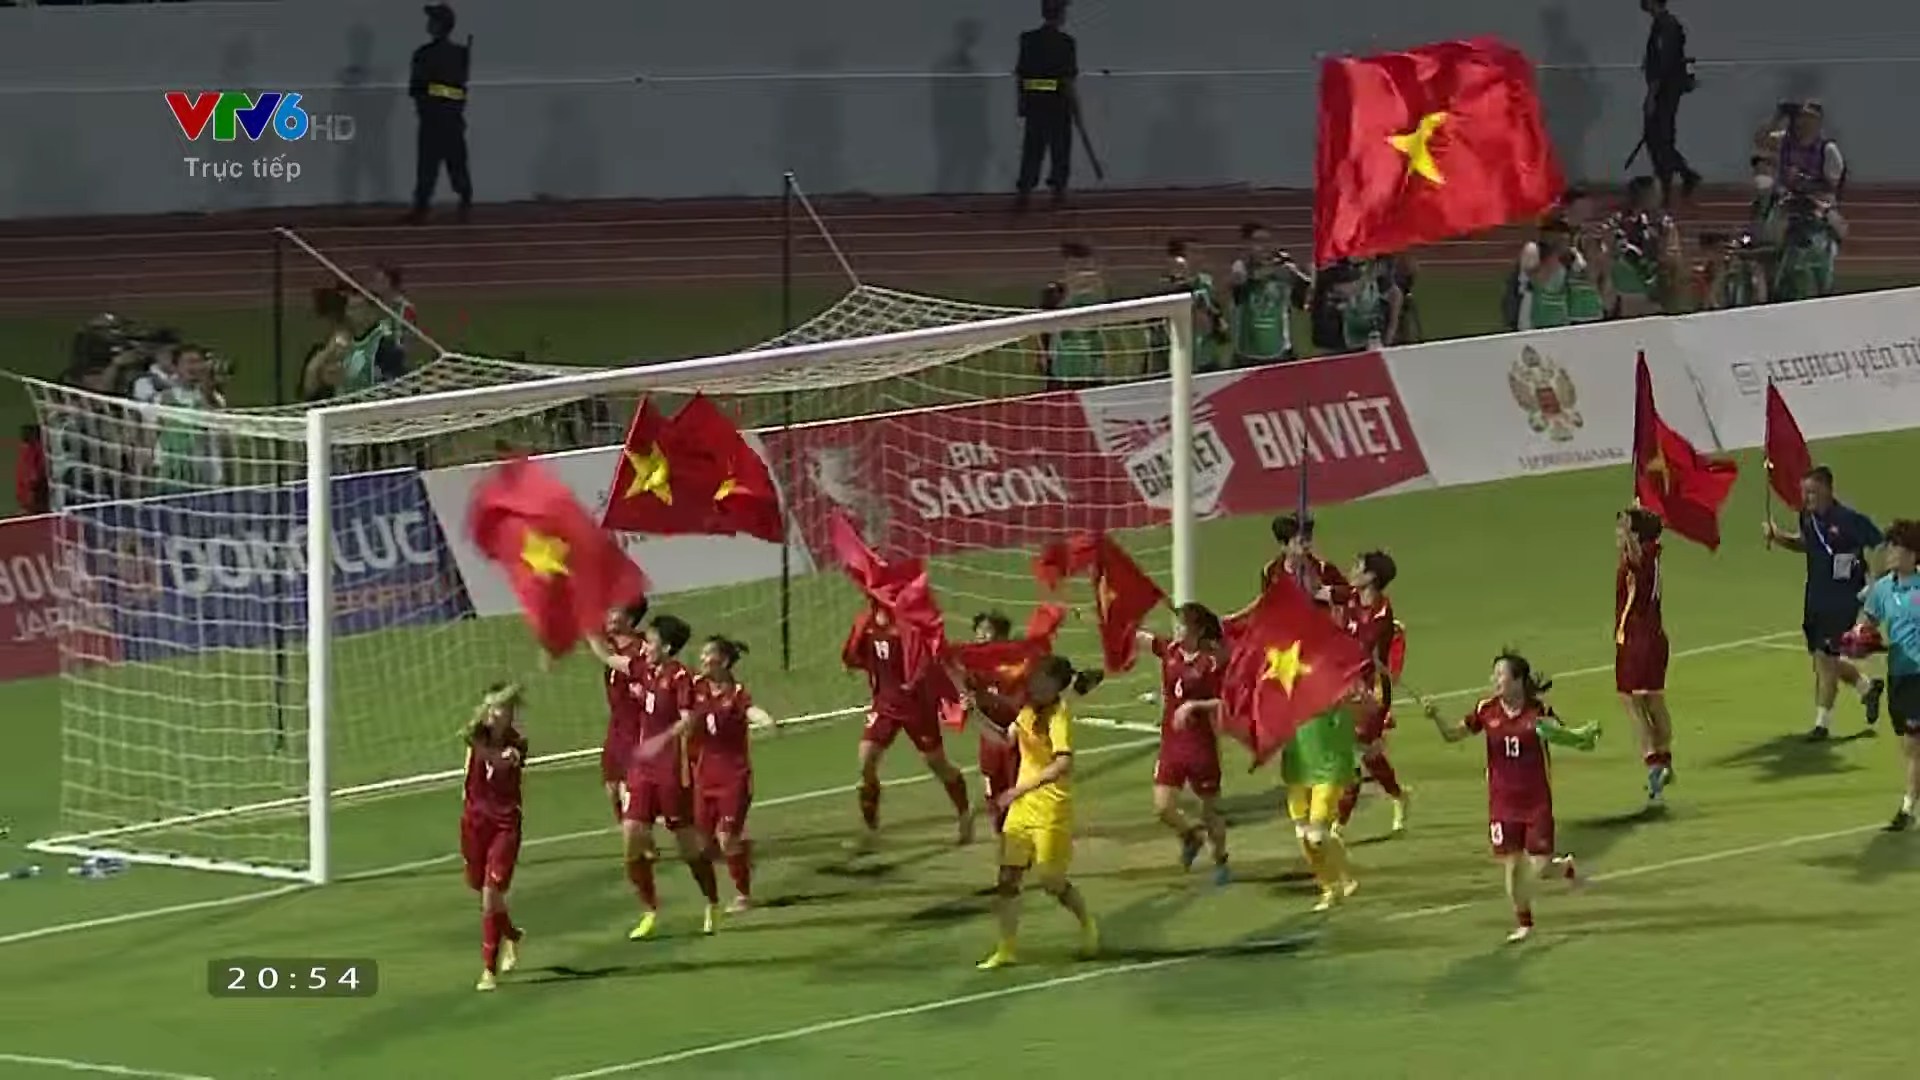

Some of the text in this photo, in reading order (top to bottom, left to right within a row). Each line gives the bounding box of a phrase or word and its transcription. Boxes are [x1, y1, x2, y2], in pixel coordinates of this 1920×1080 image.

[1893, 334, 1920, 367] T
[1242, 391, 1402, 469] BIA VIỆT
[948, 439, 999, 468] BIA
[910, 463, 1068, 519] SAIGON
[1504, 735, 1520, 757] 13
